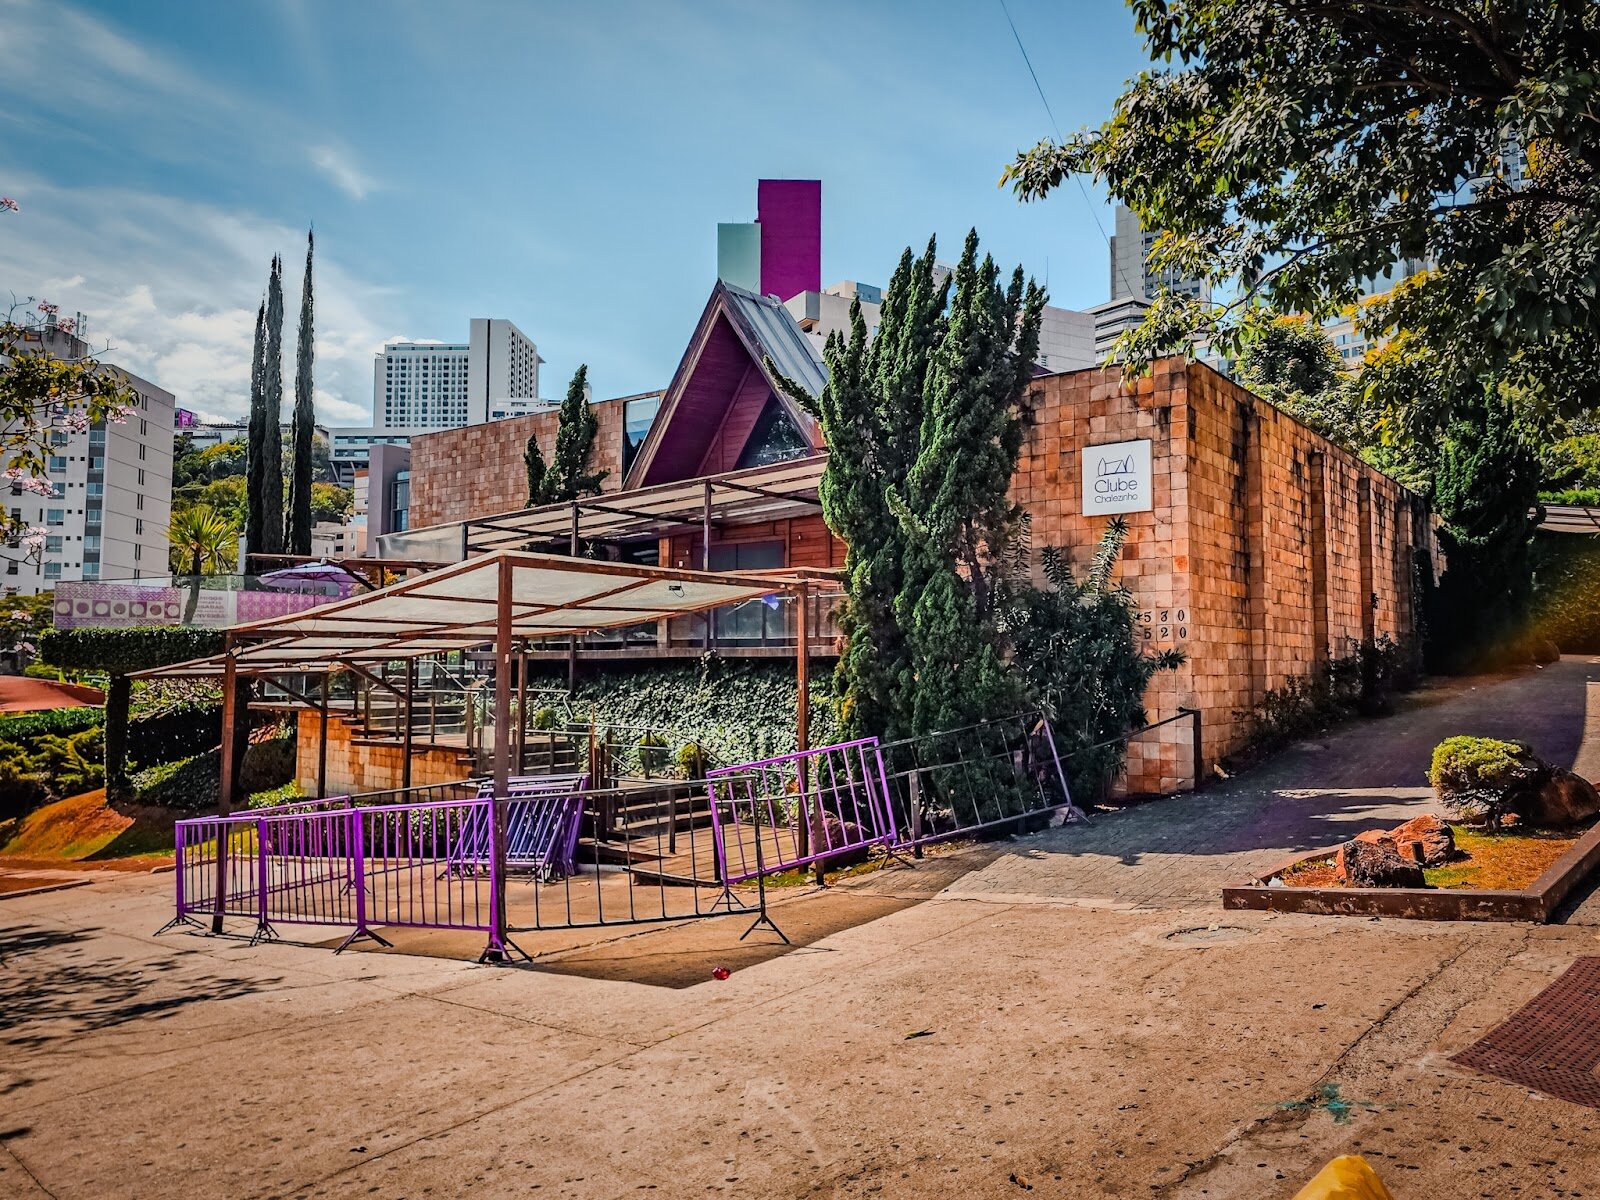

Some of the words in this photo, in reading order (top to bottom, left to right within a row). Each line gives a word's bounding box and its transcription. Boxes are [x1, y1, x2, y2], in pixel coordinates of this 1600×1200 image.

[1094, 478, 1138, 493] Clube
[1094, 493, 1138, 504] Chalezinho
[1144, 627, 1187, 639] 520
